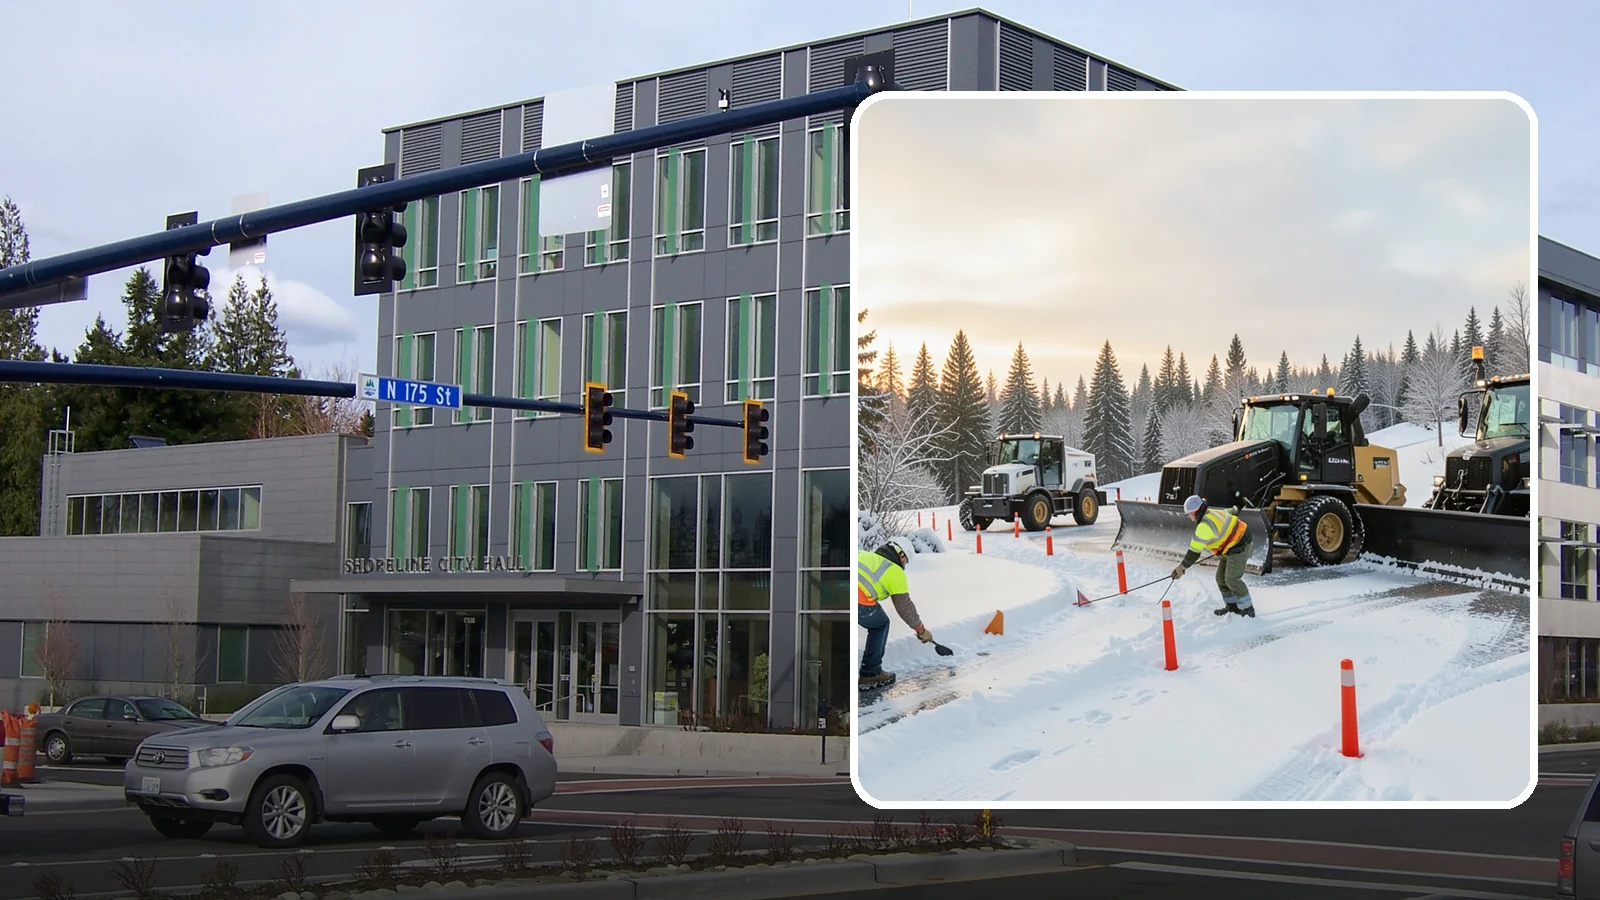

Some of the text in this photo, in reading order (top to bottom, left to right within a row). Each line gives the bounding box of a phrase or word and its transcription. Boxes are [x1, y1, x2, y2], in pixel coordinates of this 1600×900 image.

[387, 380, 451, 406] N 175 St
[344, 555, 526, 574] SHORELINE CITY HALL
